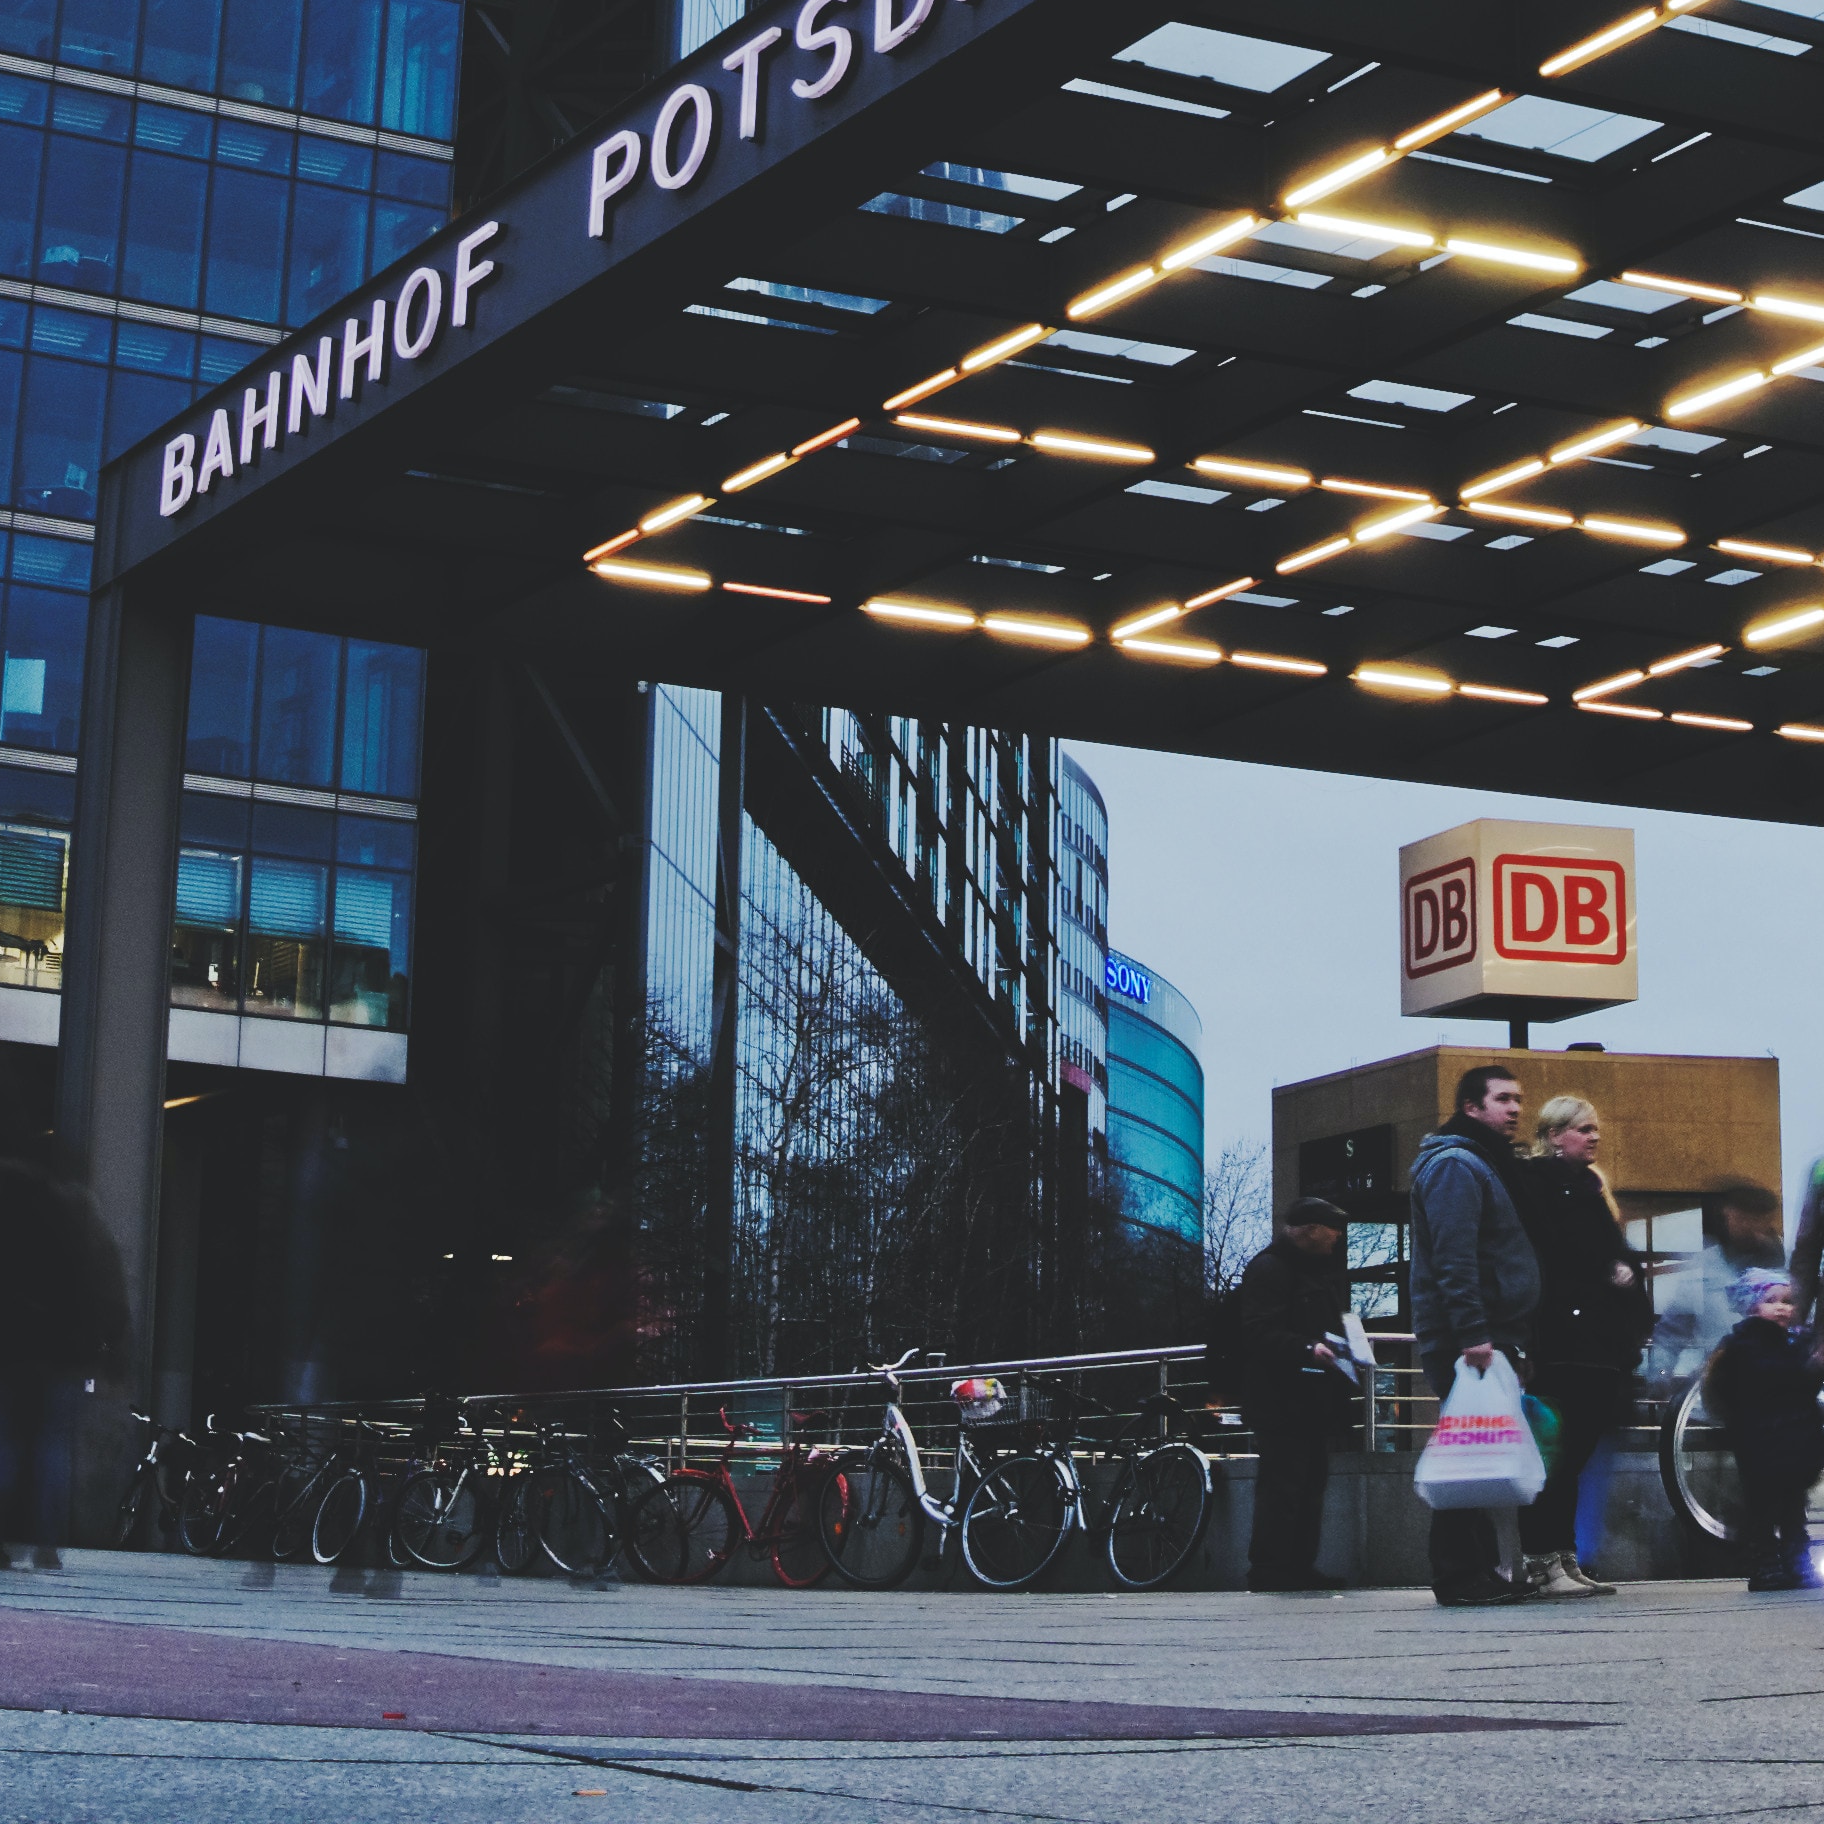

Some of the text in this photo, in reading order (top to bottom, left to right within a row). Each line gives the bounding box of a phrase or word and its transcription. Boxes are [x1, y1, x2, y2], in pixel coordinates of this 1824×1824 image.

[160, 221, 499, 517] BAHNHOF
[1414, 877, 1468, 961] DB
[1510, 871, 1611, 946] DB
[1105, 956, 1151, 1004] SONY
